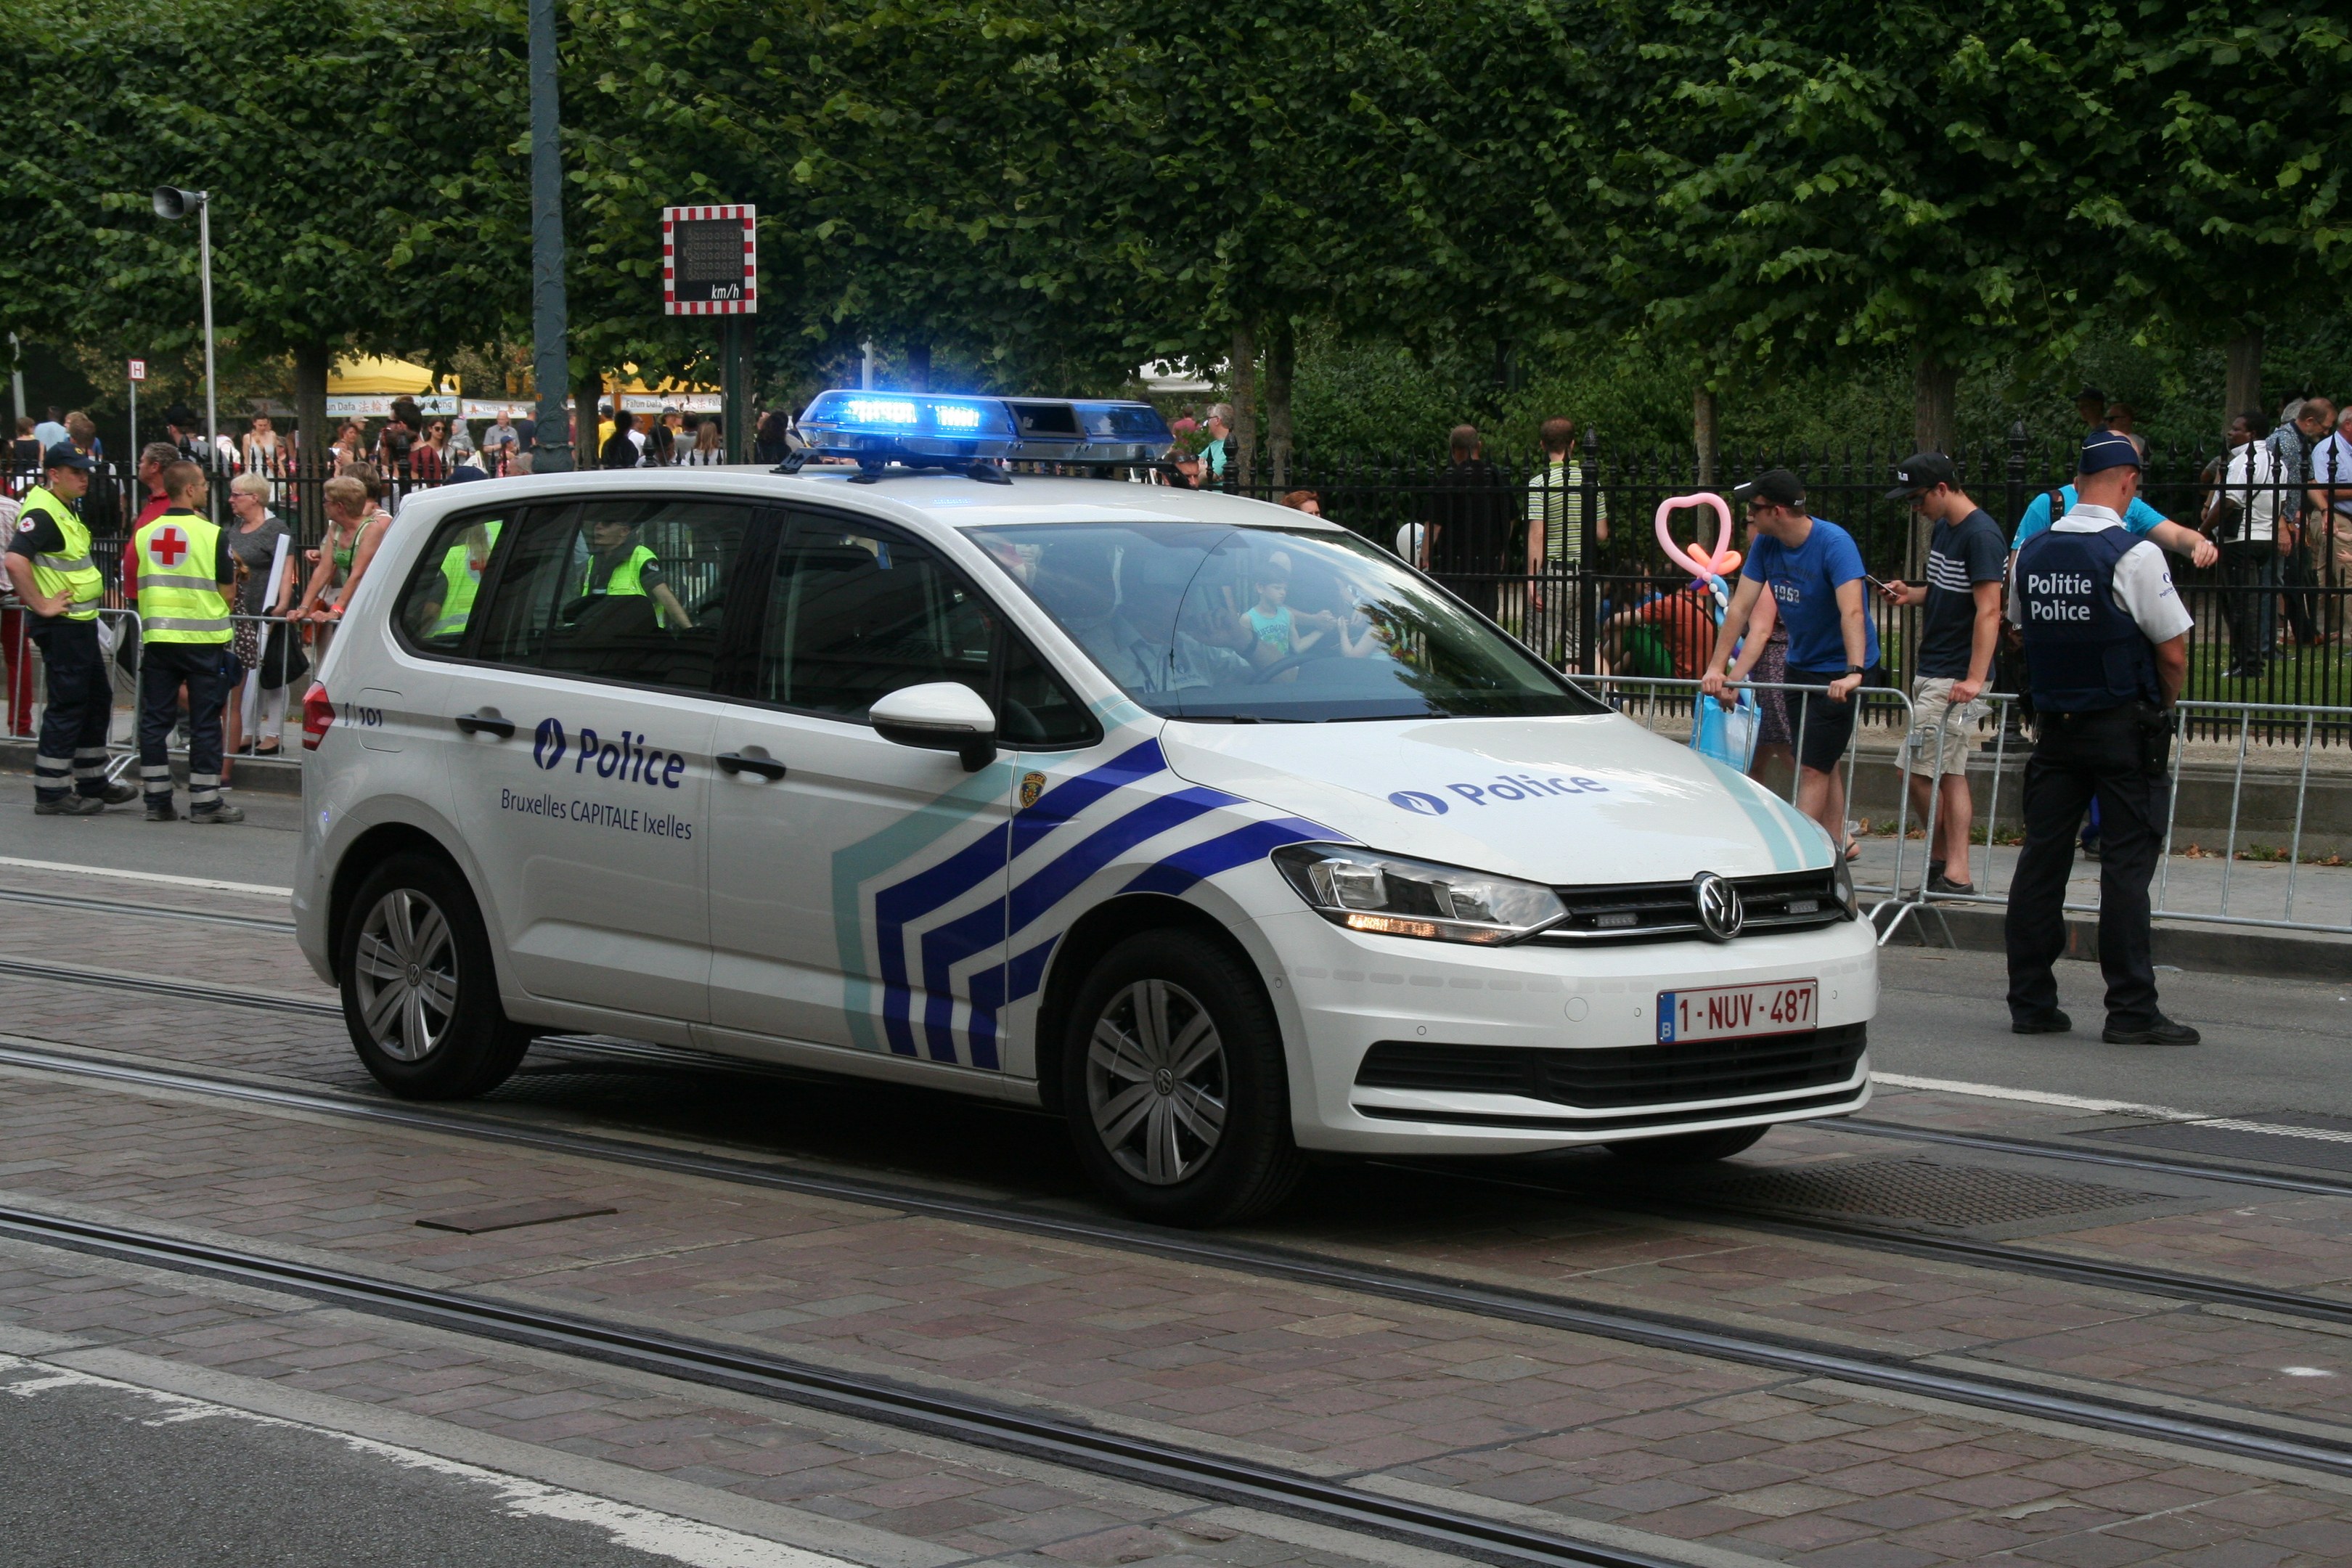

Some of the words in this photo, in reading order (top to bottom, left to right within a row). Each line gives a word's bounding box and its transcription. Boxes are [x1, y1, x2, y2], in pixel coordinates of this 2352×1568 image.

[711, 283, 739, 299] km/h
[133, 363, 142, 377] H
[338, 402, 356, 411] Dafa
[626, 399, 645, 408] Falun
[2028, 573, 2092, 595] Politie
[2030, 600, 2091, 621] Police
[576, 728, 685, 788] Police
[1446, 774, 1609, 805] Police
[502, 788, 566, 819] Bruxelles
[571, 801, 639, 831] CAPITALE
[643, 812, 693, 840] Ixelles
[1662, 1022, 1671, 1037] B
